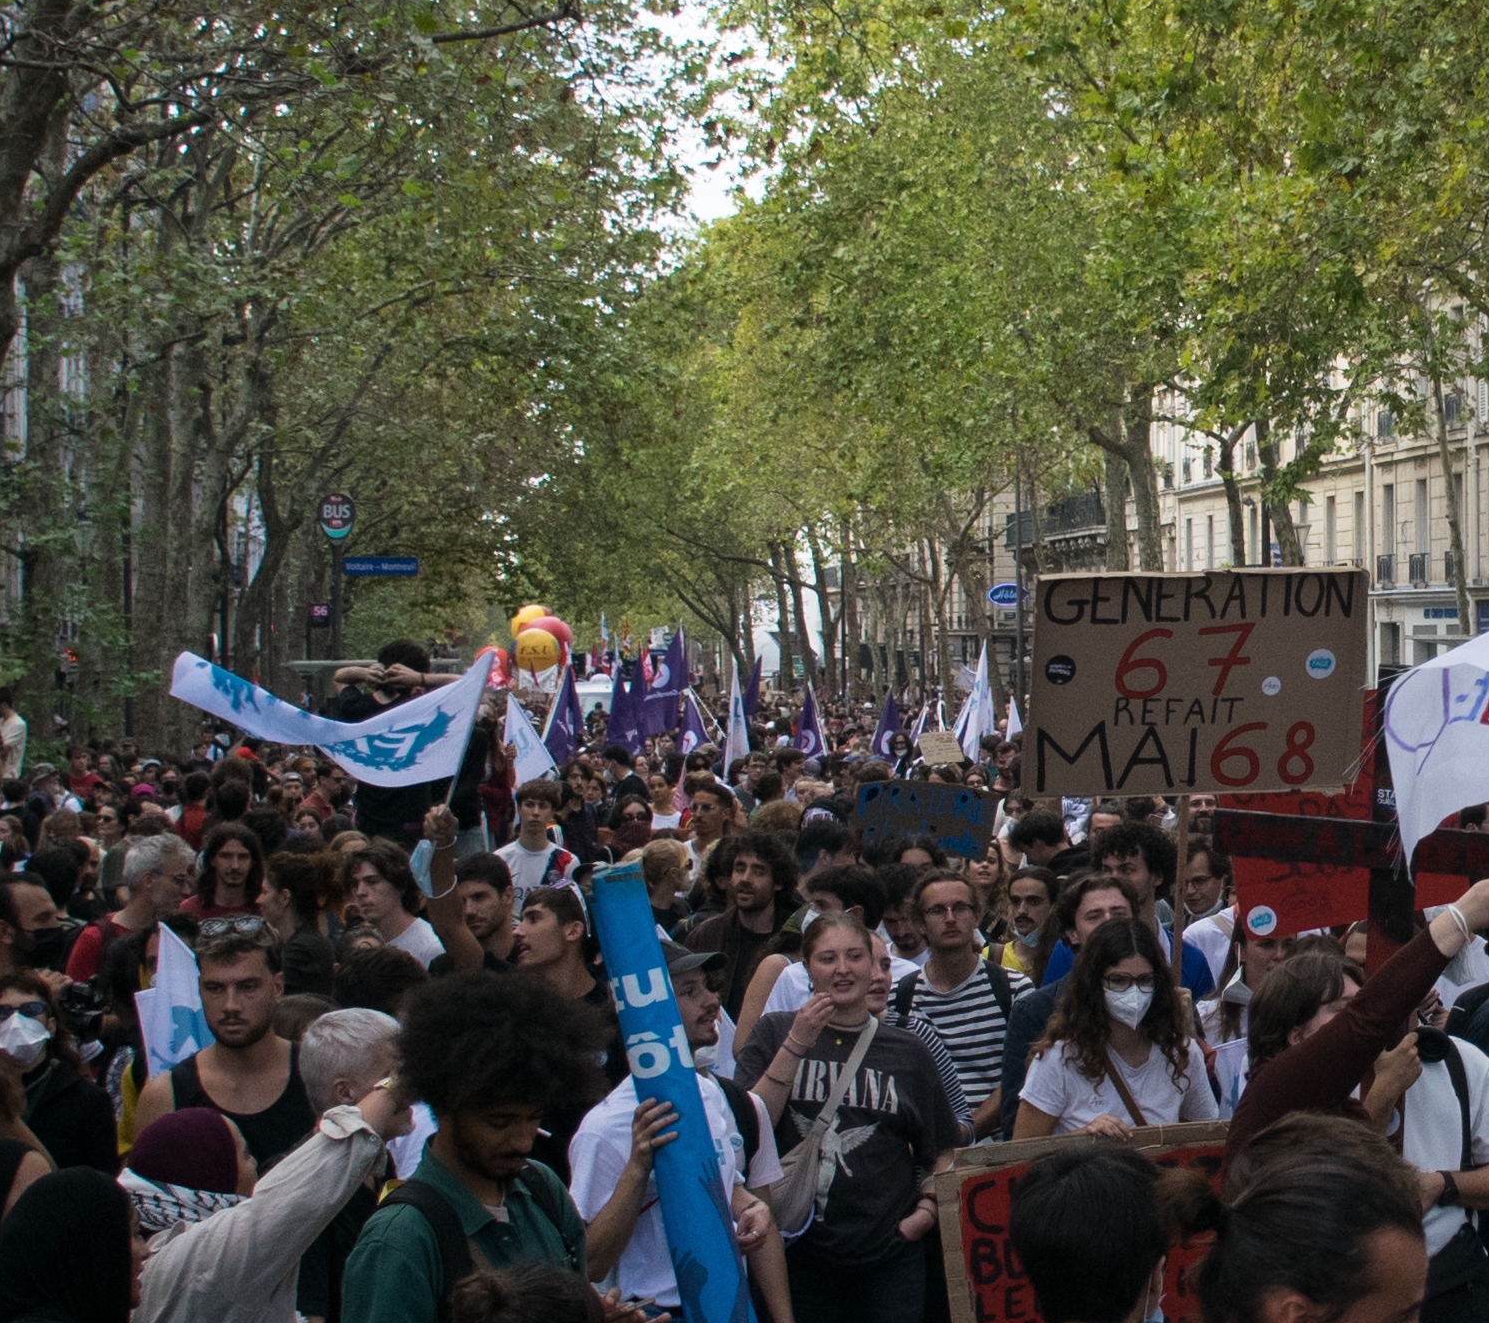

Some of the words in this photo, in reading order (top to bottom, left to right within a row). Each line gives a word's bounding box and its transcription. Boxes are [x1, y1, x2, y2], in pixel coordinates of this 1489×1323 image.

[323, 504, 350, 519] BUS
[313, 605, 328, 616] 56
[1044, 572, 1359, 625] GENERATION
[1114, 696, 1245, 727] REFAIT
[1036, 720, 1199, 793] MAI
[1211, 721, 1316, 787] 68
